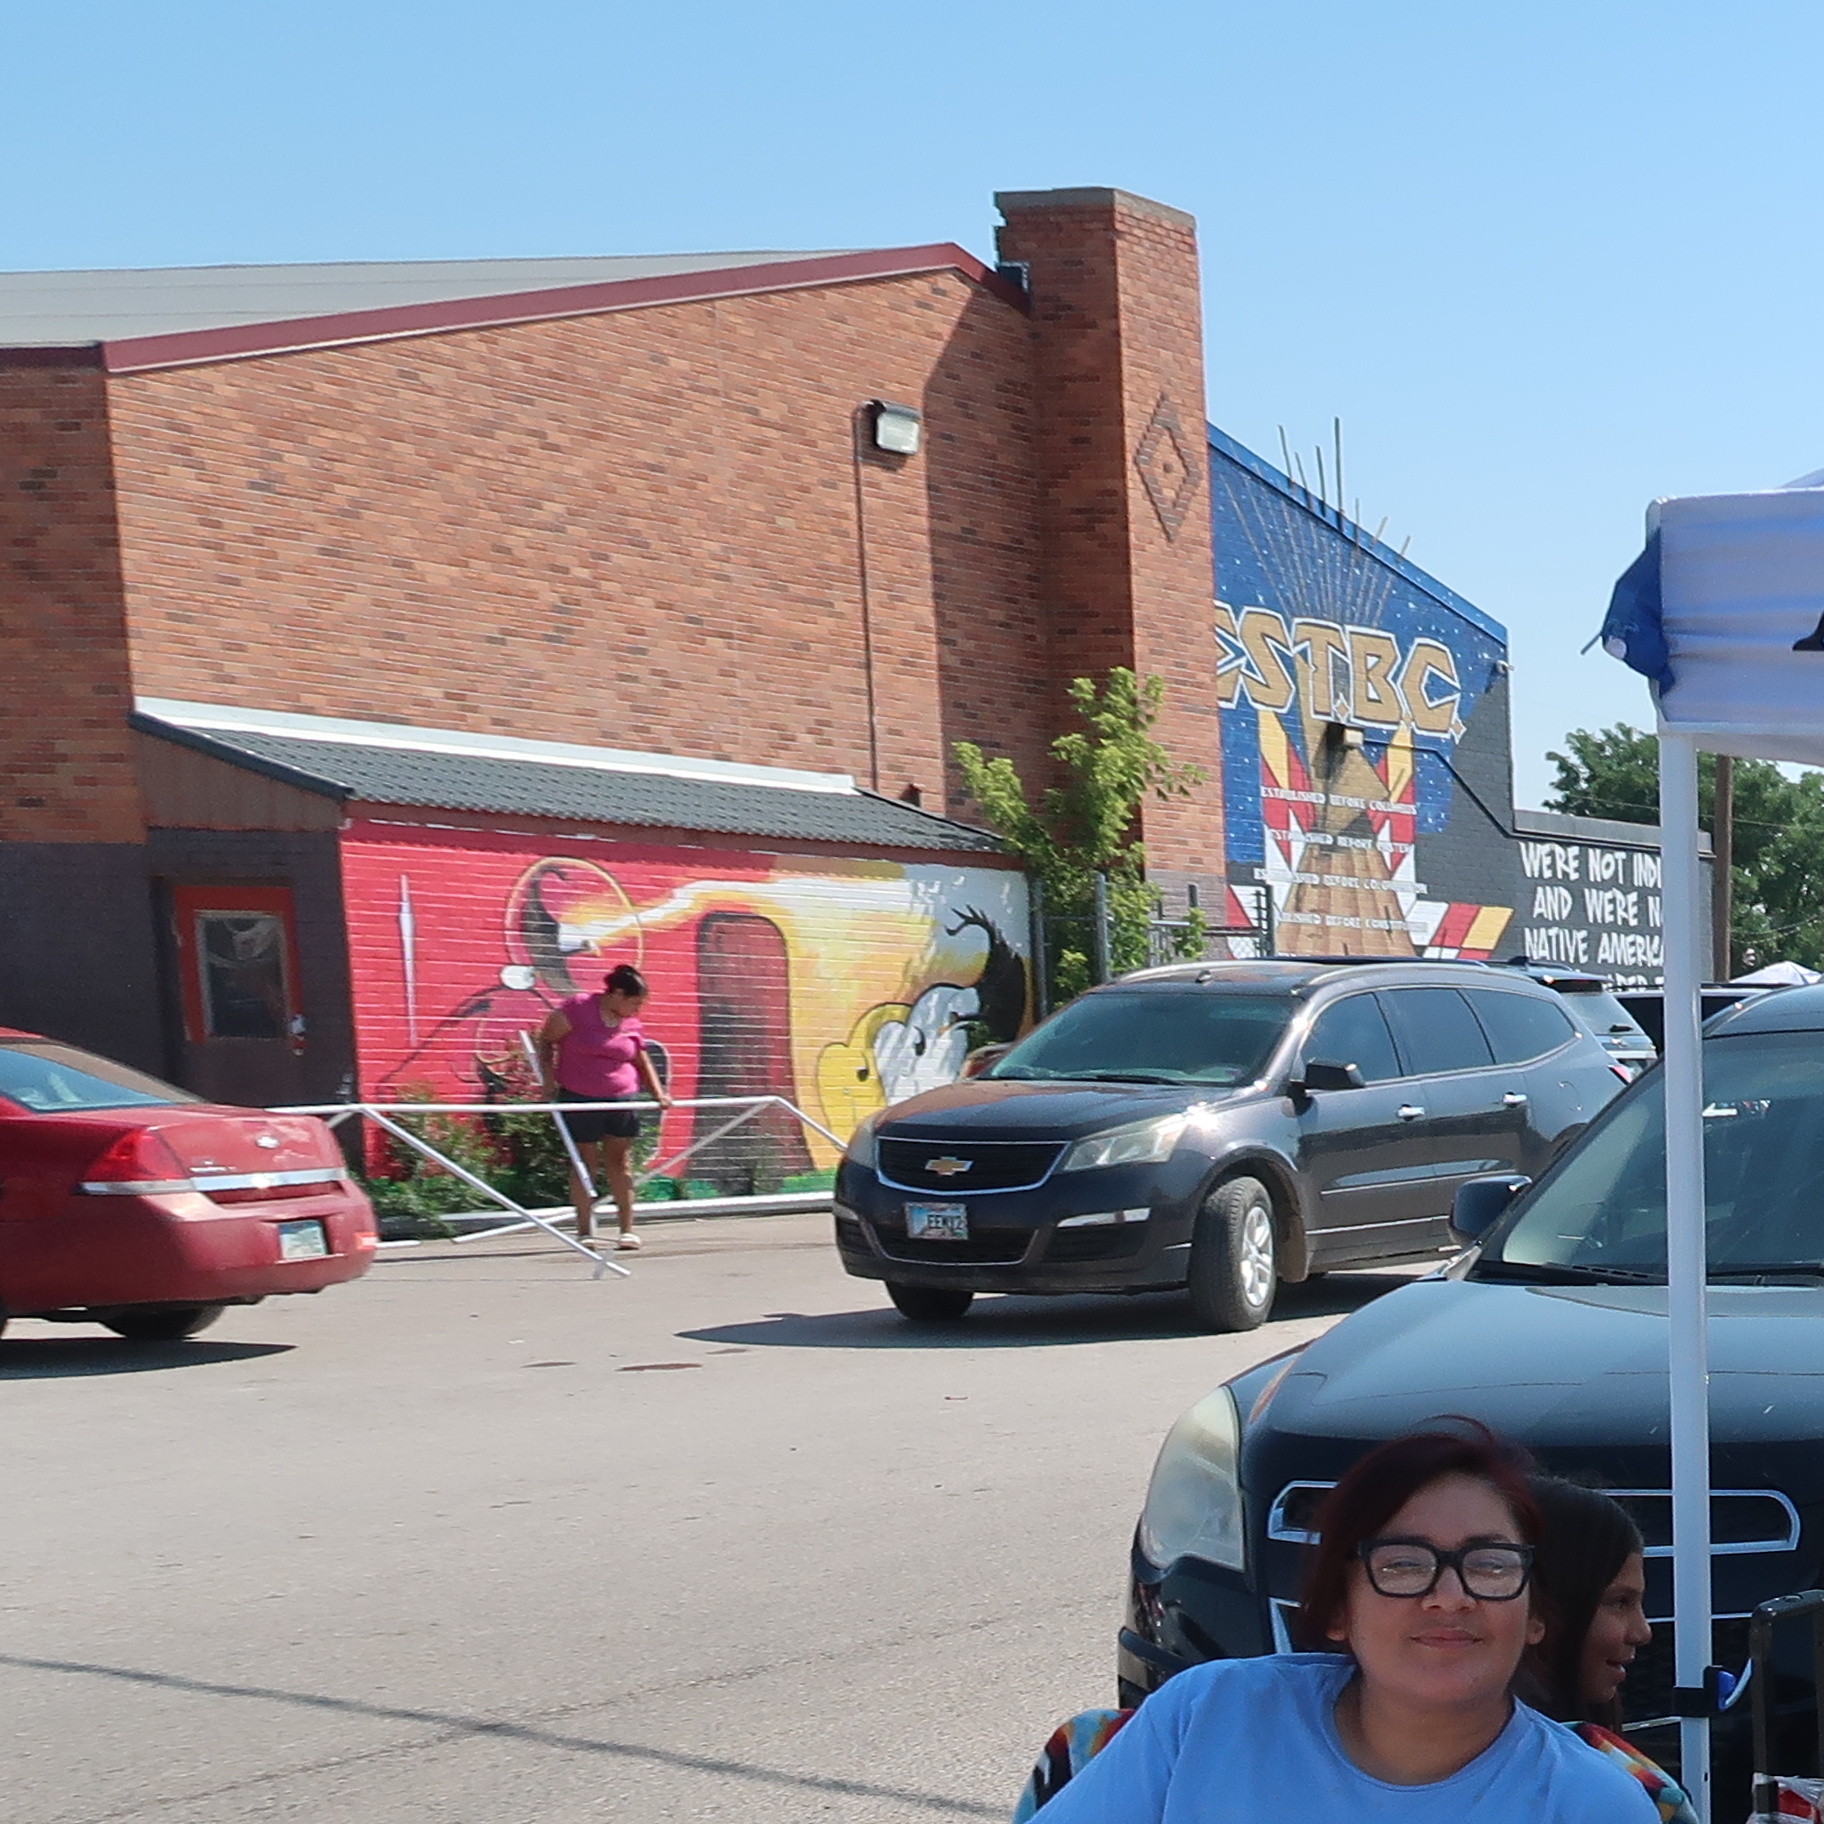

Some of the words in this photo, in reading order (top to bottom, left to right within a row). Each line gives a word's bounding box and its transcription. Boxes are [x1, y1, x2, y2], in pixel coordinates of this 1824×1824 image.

[1518, 841, 1580, 882] WERE
[1587, 847, 1627, 884] NOT
[1532, 886, 1573, 922] AND
[1583, 886, 1639, 927] WERE
[1524, 926, 1589, 964] NATIVE
